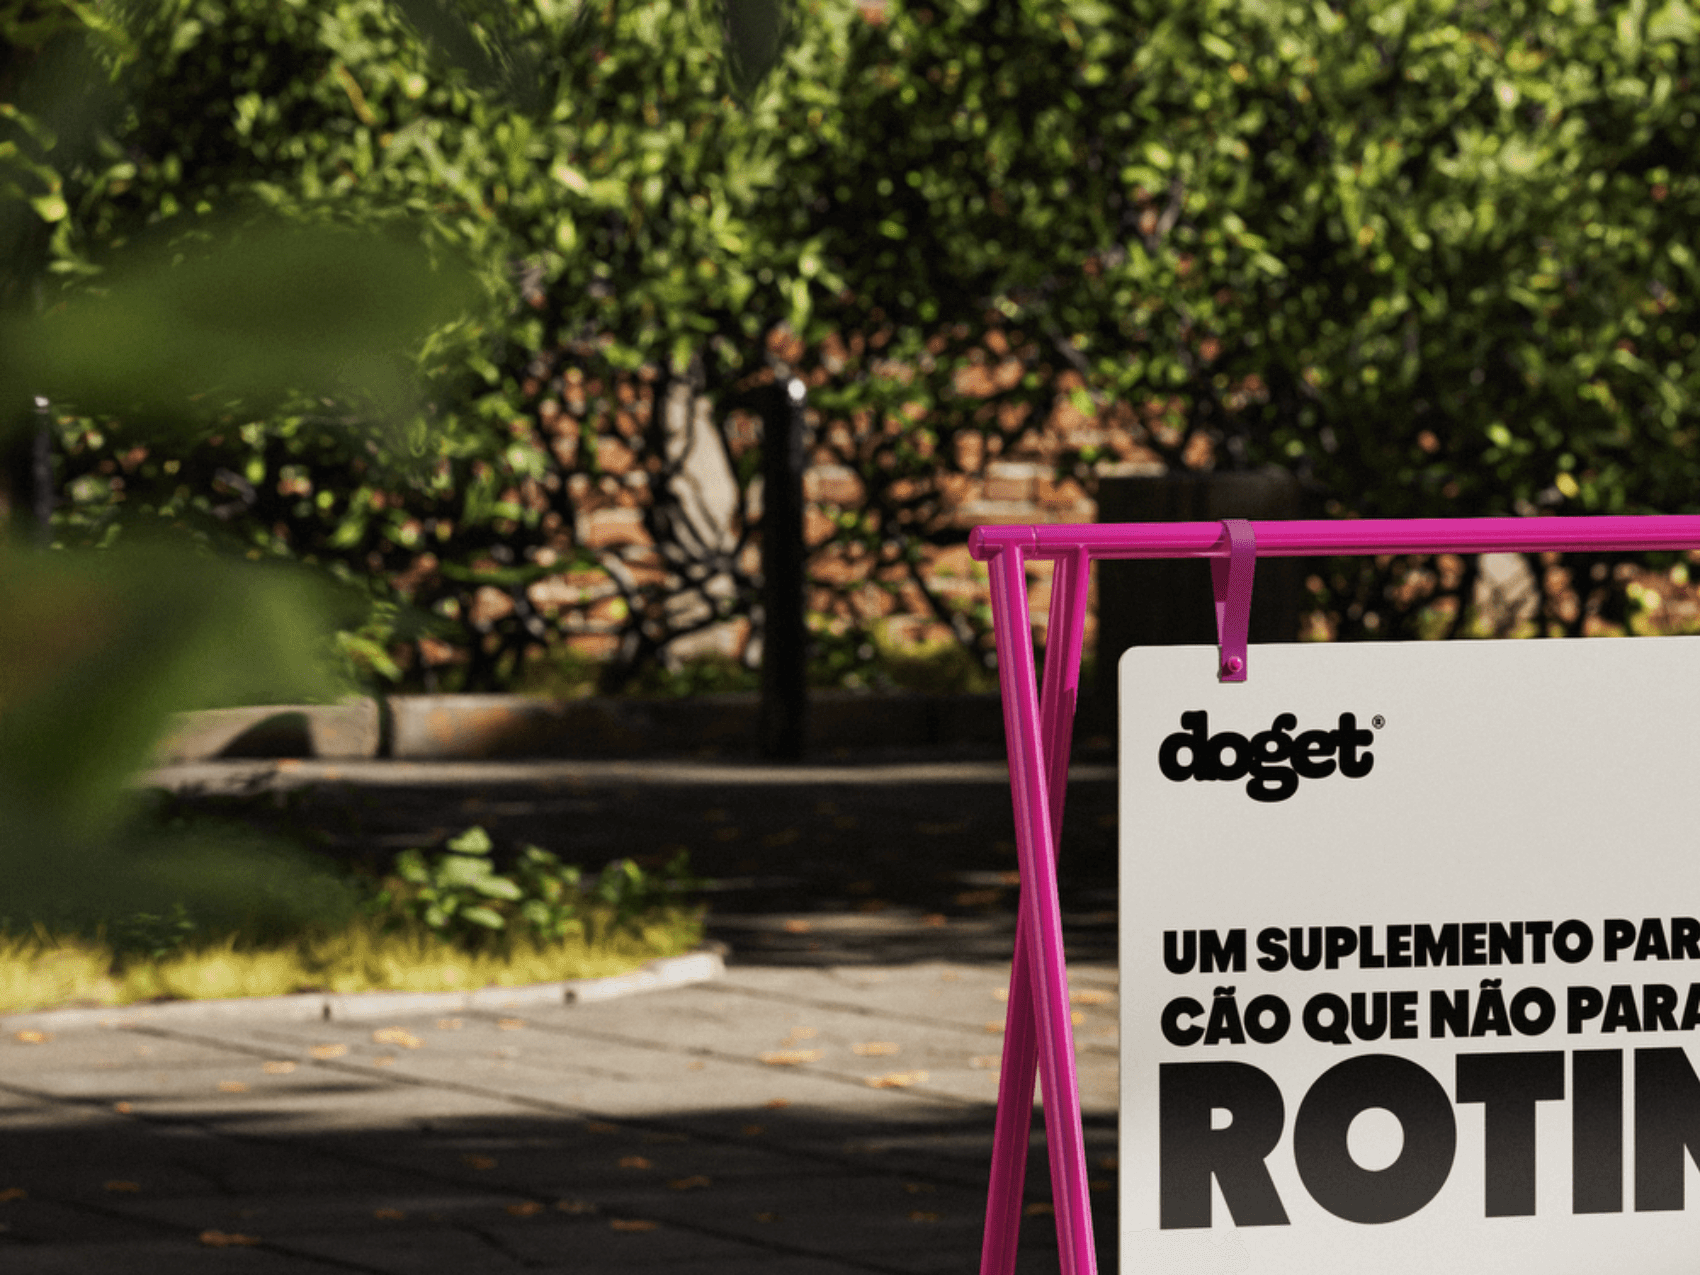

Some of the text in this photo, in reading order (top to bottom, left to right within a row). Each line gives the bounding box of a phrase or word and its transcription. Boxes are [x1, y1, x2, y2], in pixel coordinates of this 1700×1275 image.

[1162, 928, 1247, 975] UM
[1256, 919, 1594, 972] SUPLEMENTO
[1160, 986, 1291, 1047] CÃO
[1302, 992, 1418, 1045] QUE
[1429, 978, 1557, 1038] NÃO
